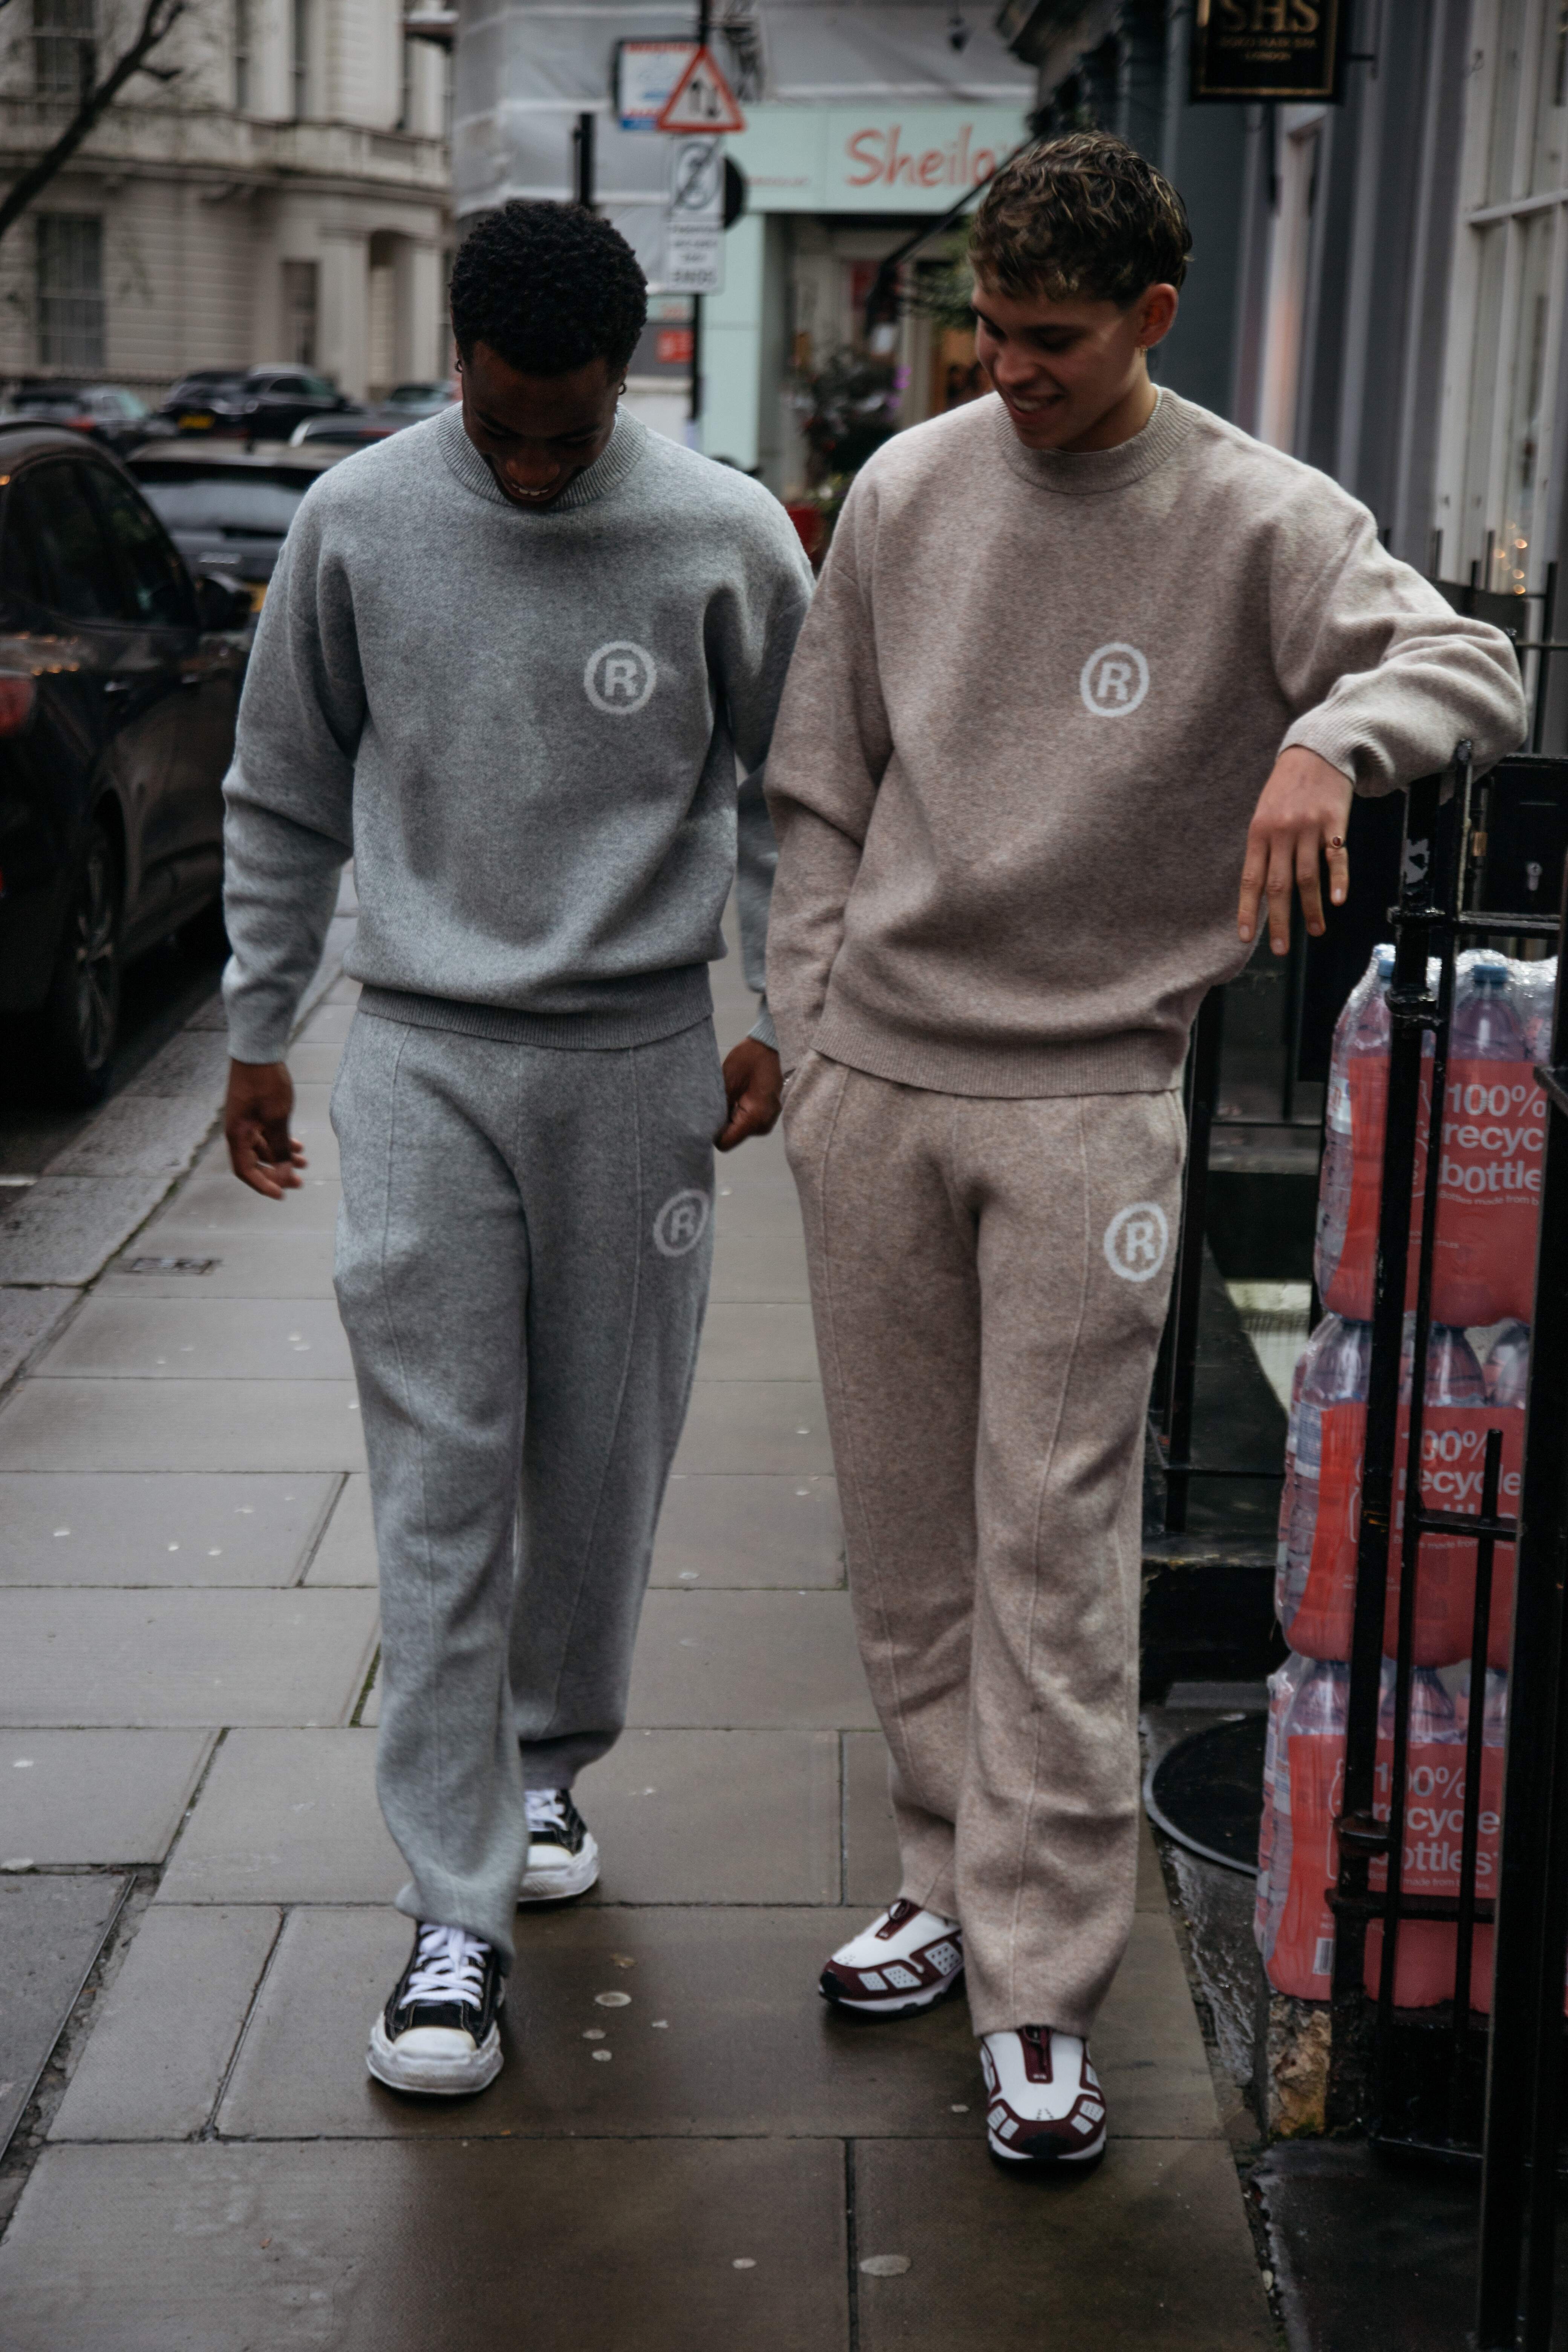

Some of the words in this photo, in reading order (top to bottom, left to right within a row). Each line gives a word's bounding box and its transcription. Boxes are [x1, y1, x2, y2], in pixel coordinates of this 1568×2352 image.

[1445, 1083, 1546, 1118] 100%
[1442, 1122, 1544, 1157] recyc
[1439, 1155, 1541, 1194] bottle
[1401, 1430, 1487, 1462] 00%
[1375, 1762, 1466, 1799] 10%
